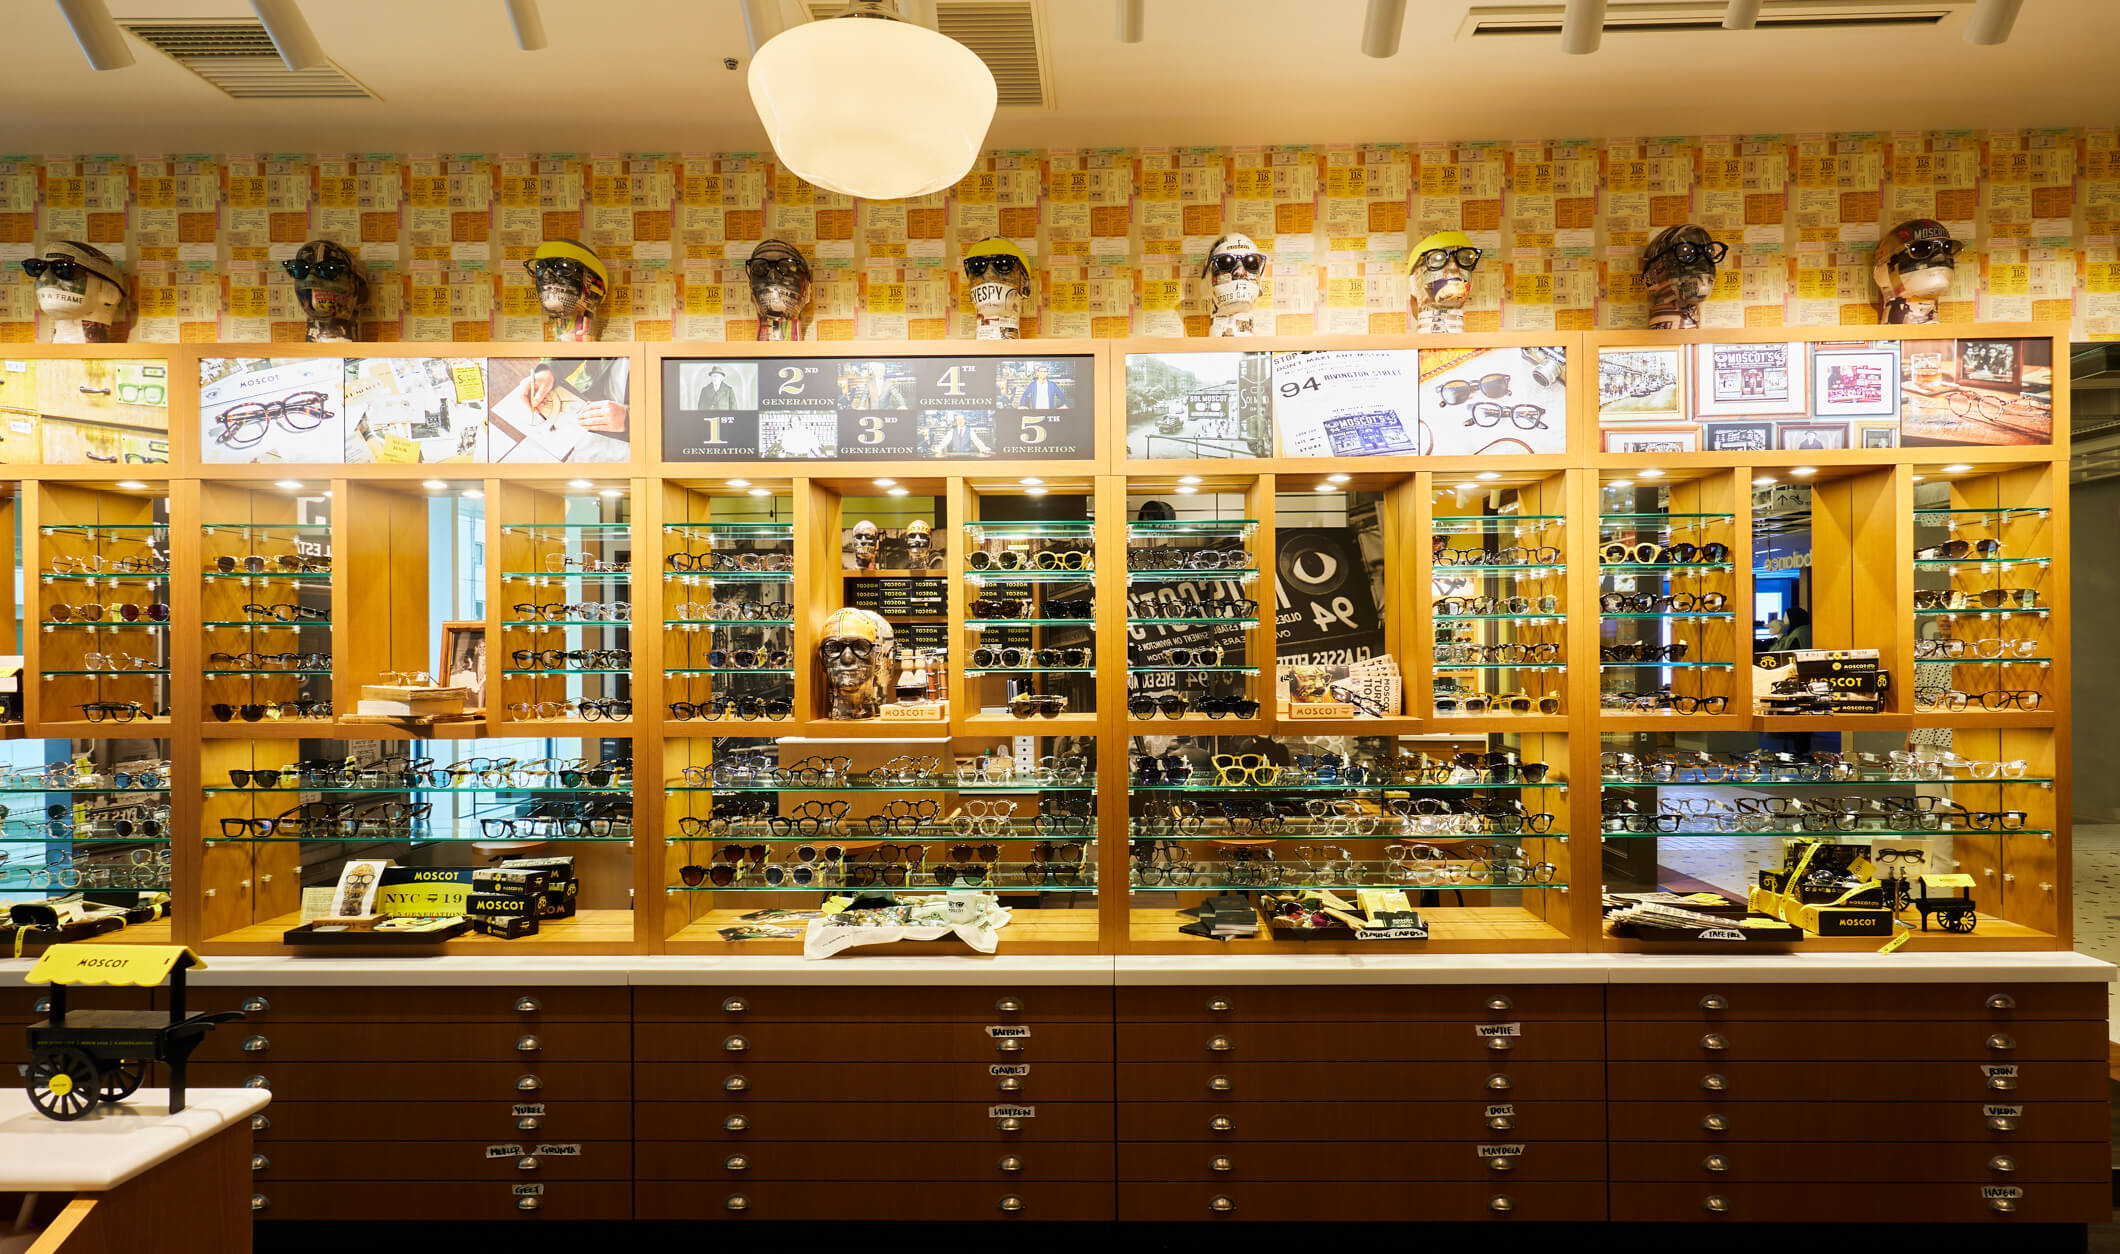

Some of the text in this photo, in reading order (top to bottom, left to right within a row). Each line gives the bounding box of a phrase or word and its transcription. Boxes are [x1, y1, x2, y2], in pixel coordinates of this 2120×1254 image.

[1273, 352, 1298, 365] STOP
[1727, 352, 1774, 364] MOSCOT'S
[240, 373, 279, 387] MOSCOT
[1280, 369, 1402, 398] 94 RIVINGTON STREET
[762, 398, 835, 406] GENERATION
[920, 398, 992, 406] GENERATION
[1338, 415, 1386, 428] MOSCOT'S
[683, 447, 755, 455] GENERATION
[841, 446, 913, 454] GENERATION
[885, 709, 924, 717] MOSCOT
[1296, 707, 1337, 716] MOSCOT
[414, 871, 459, 881] MOSCOT
[385, 893, 420, 904] NYC
[476, 900, 525, 911] MOSCOT
[1839, 918, 1876, 926] MOSCOT
[78, 959, 129, 968] MOSCOT
